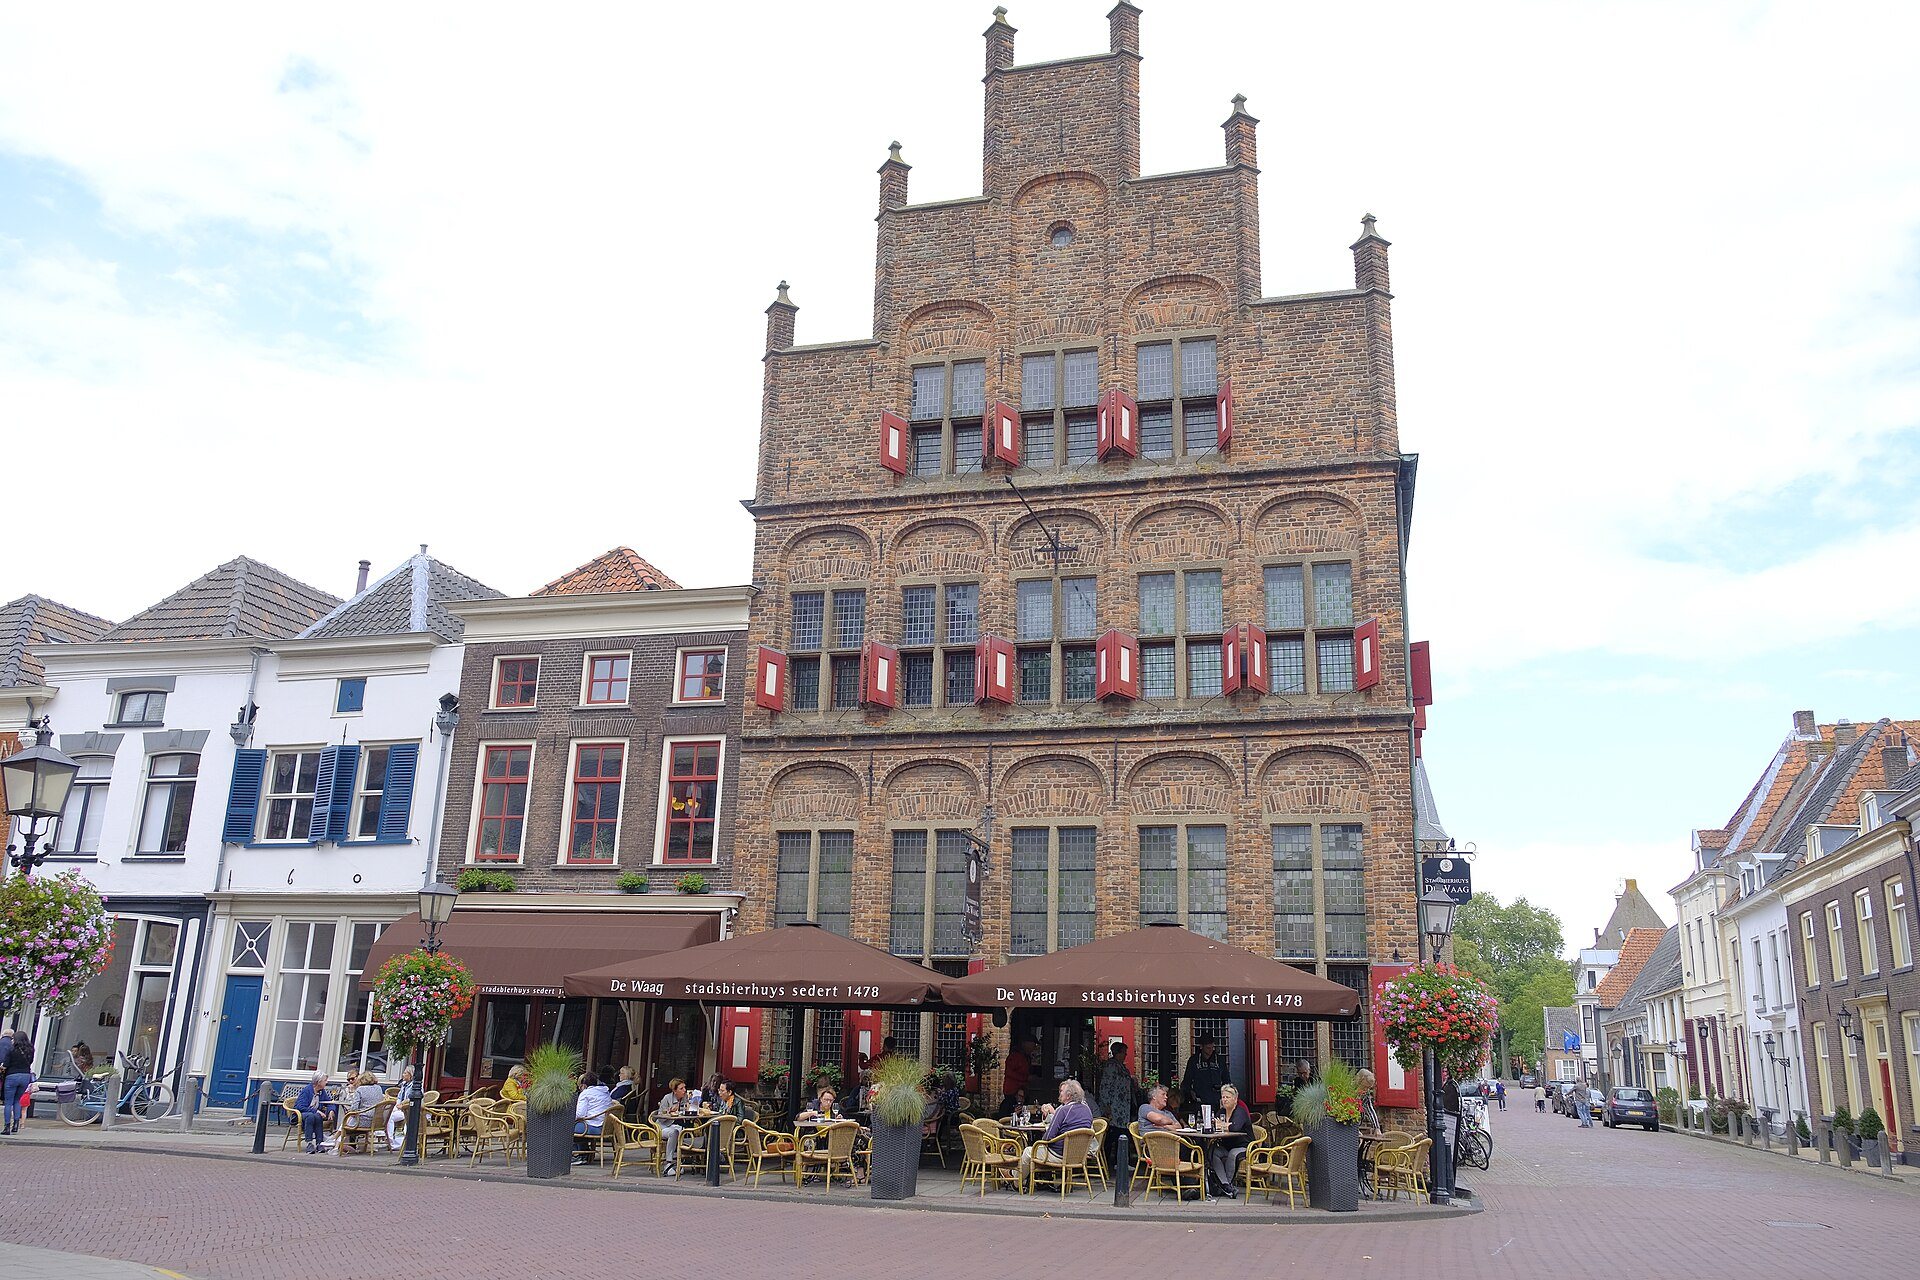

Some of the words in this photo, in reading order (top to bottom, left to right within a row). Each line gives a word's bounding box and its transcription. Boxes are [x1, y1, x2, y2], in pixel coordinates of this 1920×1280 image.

[481, 985, 530, 995] stadsbierhuys
[533, 987, 555, 995] sedert
[610, 979, 627, 992] De
[631, 980, 664, 996] Waag
[685, 982, 785, 999] stadsbierhuys
[792, 984, 838, 998] sedert
[847, 985, 880, 998] 1478
[996, 987, 1014, 1001] De
[1019, 988, 1057, 1005] Waag
[1081, 989, 1196, 1006] stadsbierhuys
[1203, 991, 1256, 1006] sedert
[1266, 993, 1303, 1007] 1478
